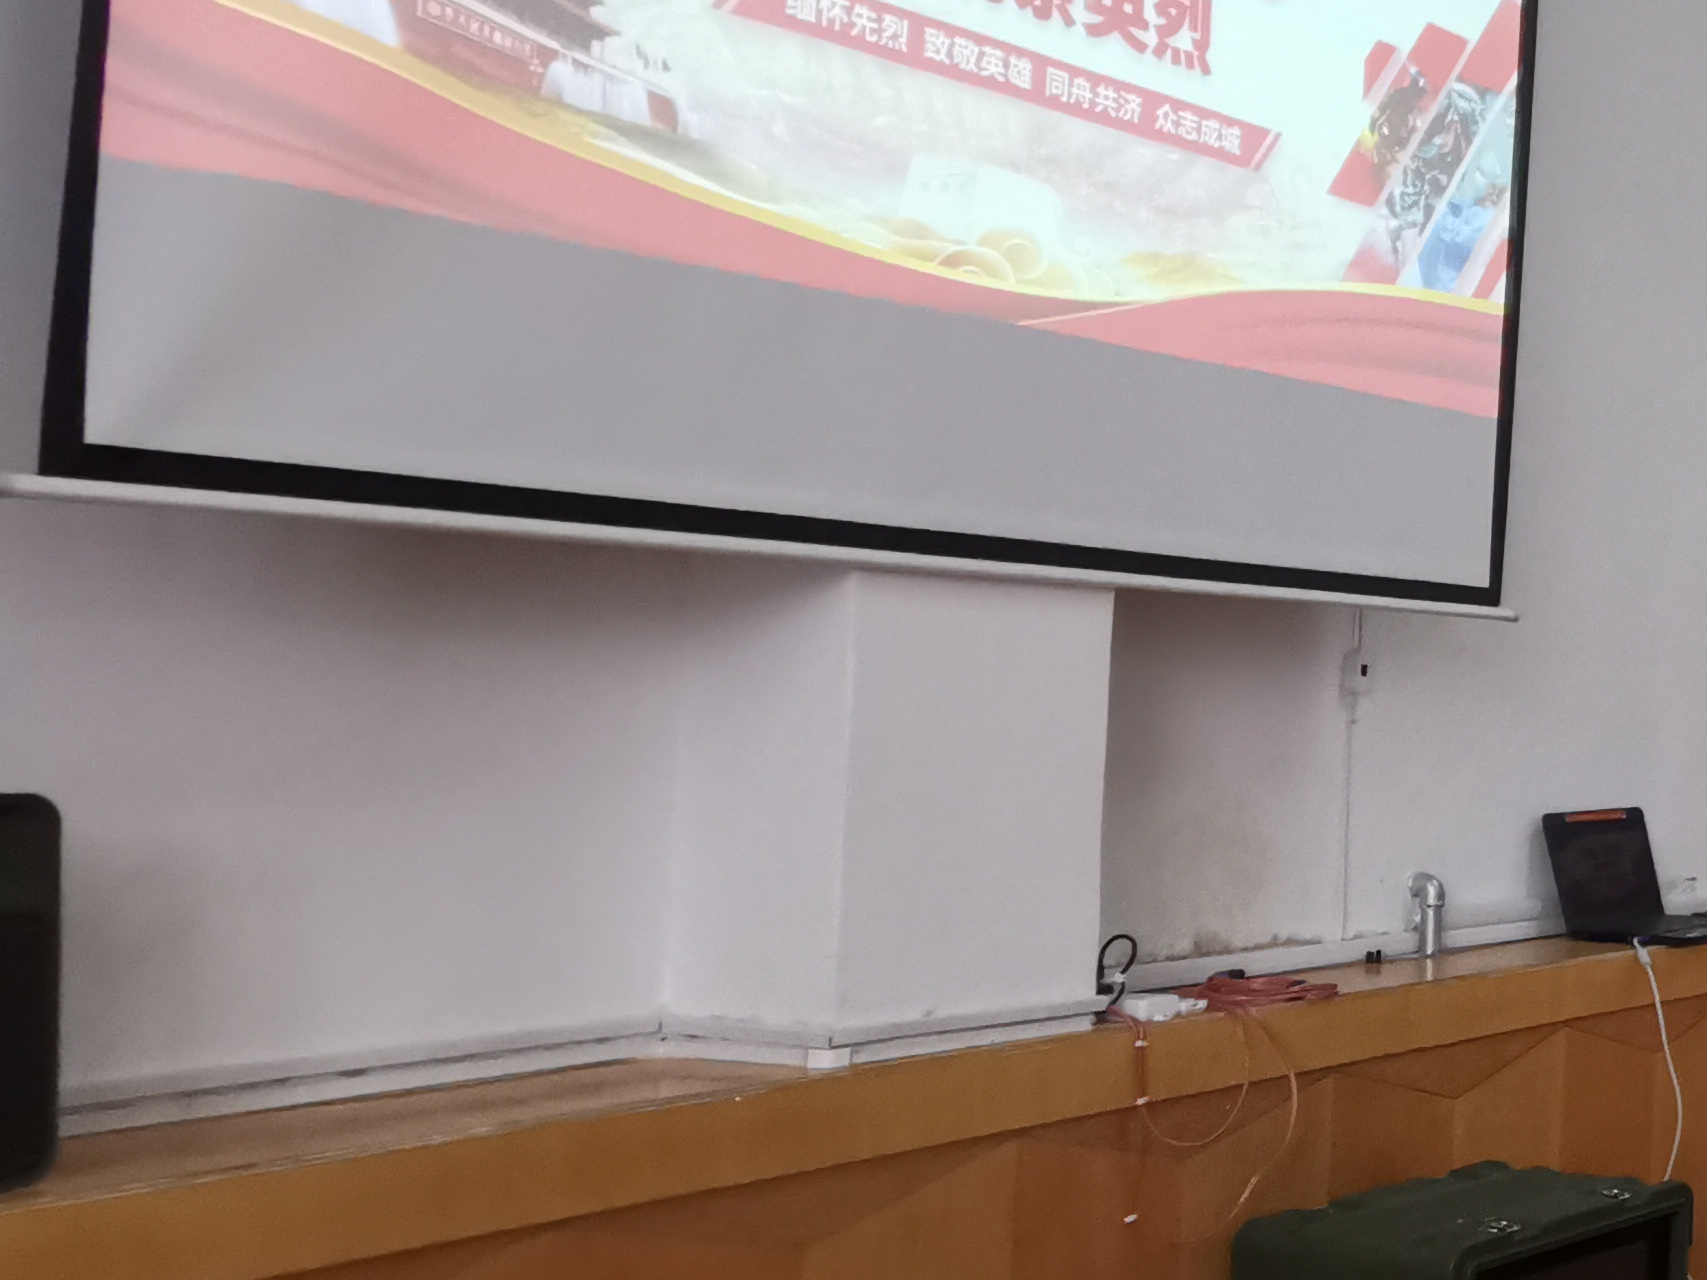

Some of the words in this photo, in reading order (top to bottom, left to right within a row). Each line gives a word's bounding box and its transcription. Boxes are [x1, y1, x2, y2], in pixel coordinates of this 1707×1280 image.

[923, 27, 1033, 90] 致敬英雄
[1045, 66, 1143, 123] 同舟共济
[1155, 104, 1242, 156] 众志成城
